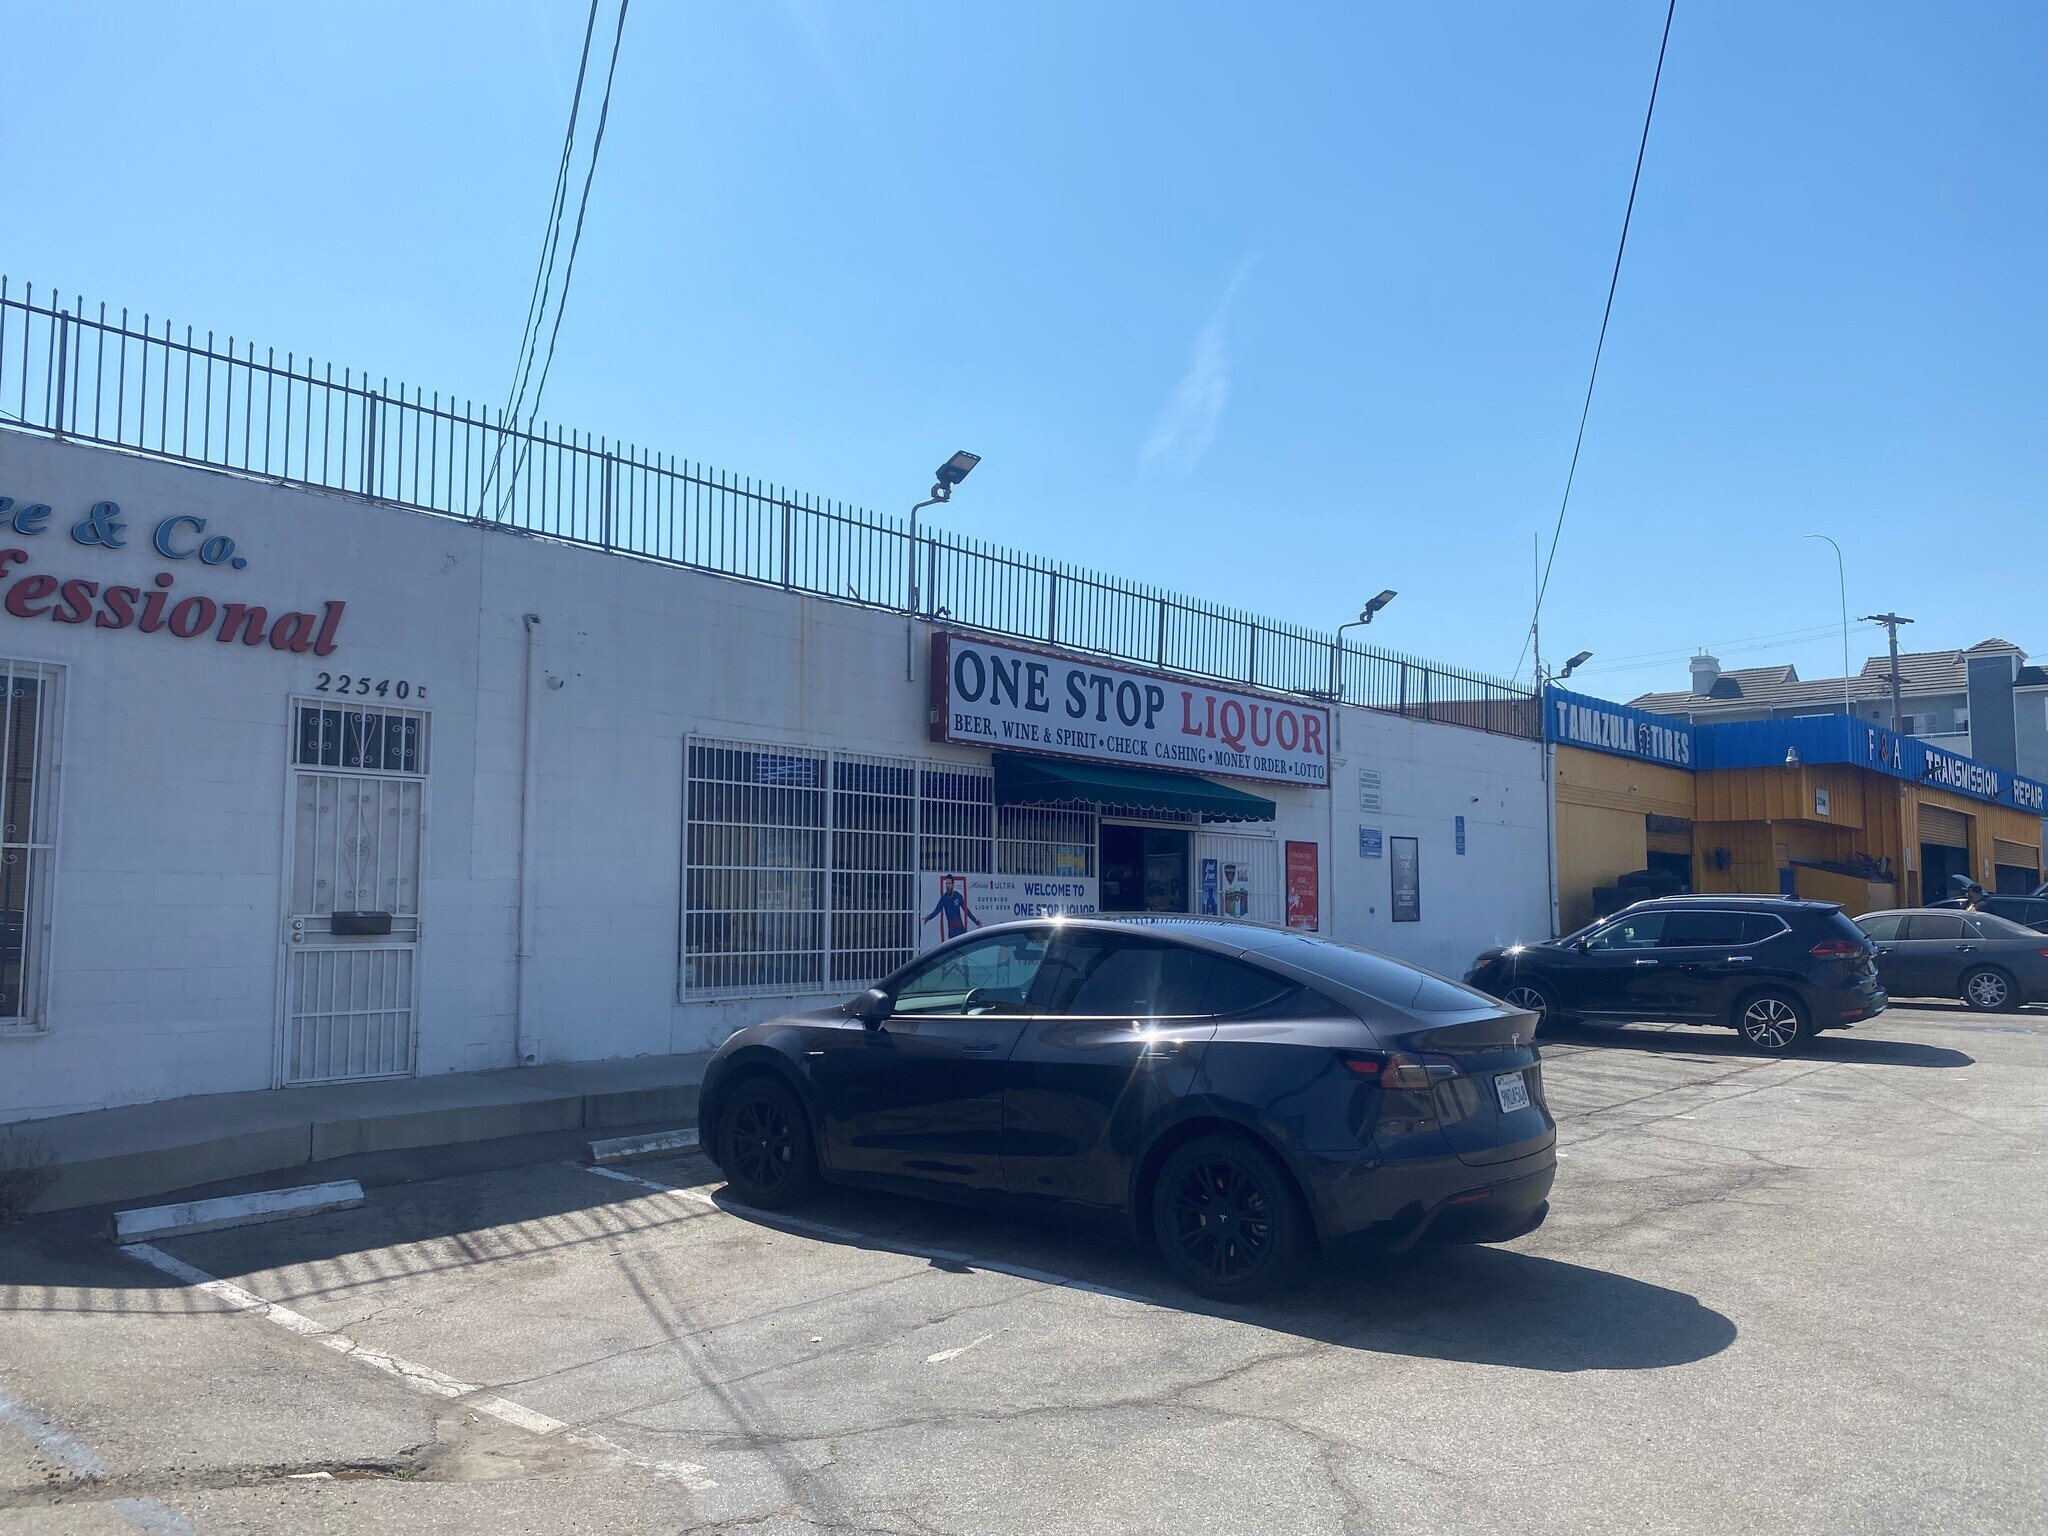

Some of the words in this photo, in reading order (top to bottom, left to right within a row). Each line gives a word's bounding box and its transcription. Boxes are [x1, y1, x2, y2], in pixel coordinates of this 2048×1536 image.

[71, 501, 127, 549] &
[154, 515, 248, 569] Co.
[315, 672, 410, 699] 22540
[954, 649, 1050, 713] ONE
[1066, 670, 1165, 730] STOP
[1181, 691, 1324, 755] LIQUOR
[954, 713, 998, 739] BEER,
[1002, 720, 1039, 742] WINE
[1043, 727, 1052, 744] &
[1056, 728, 1097, 749] SPIRIT
[1107, 735, 1148, 756] CHECK
[1155, 742, 1206, 764] CASHING
[1214, 750, 1251, 770] MONEY
[1253, 756, 1287, 775] ORDER
[1294, 761, 1325, 779] LOTTO
[1556, 701, 1636, 751] TAMAZULA
[1650, 725, 1689, 764] TIRES
[1867, 728, 1875, 761] F
[1880, 734, 1888, 762] &
[1893, 738, 1901, 770] A
[1925, 750, 1998, 796] TRANSMISSION
[2013, 779, 2043, 809] REPAIR
[1396, 852, 1414, 861] THANK
[994, 882, 1016, 890] ULTRA
[1024, 882, 1071, 897] WELCOME
[1072, 884, 1085, 897] TO
[1013, 903, 1034, 917] ONE
[1036, 903, 1059, 917] STOP
